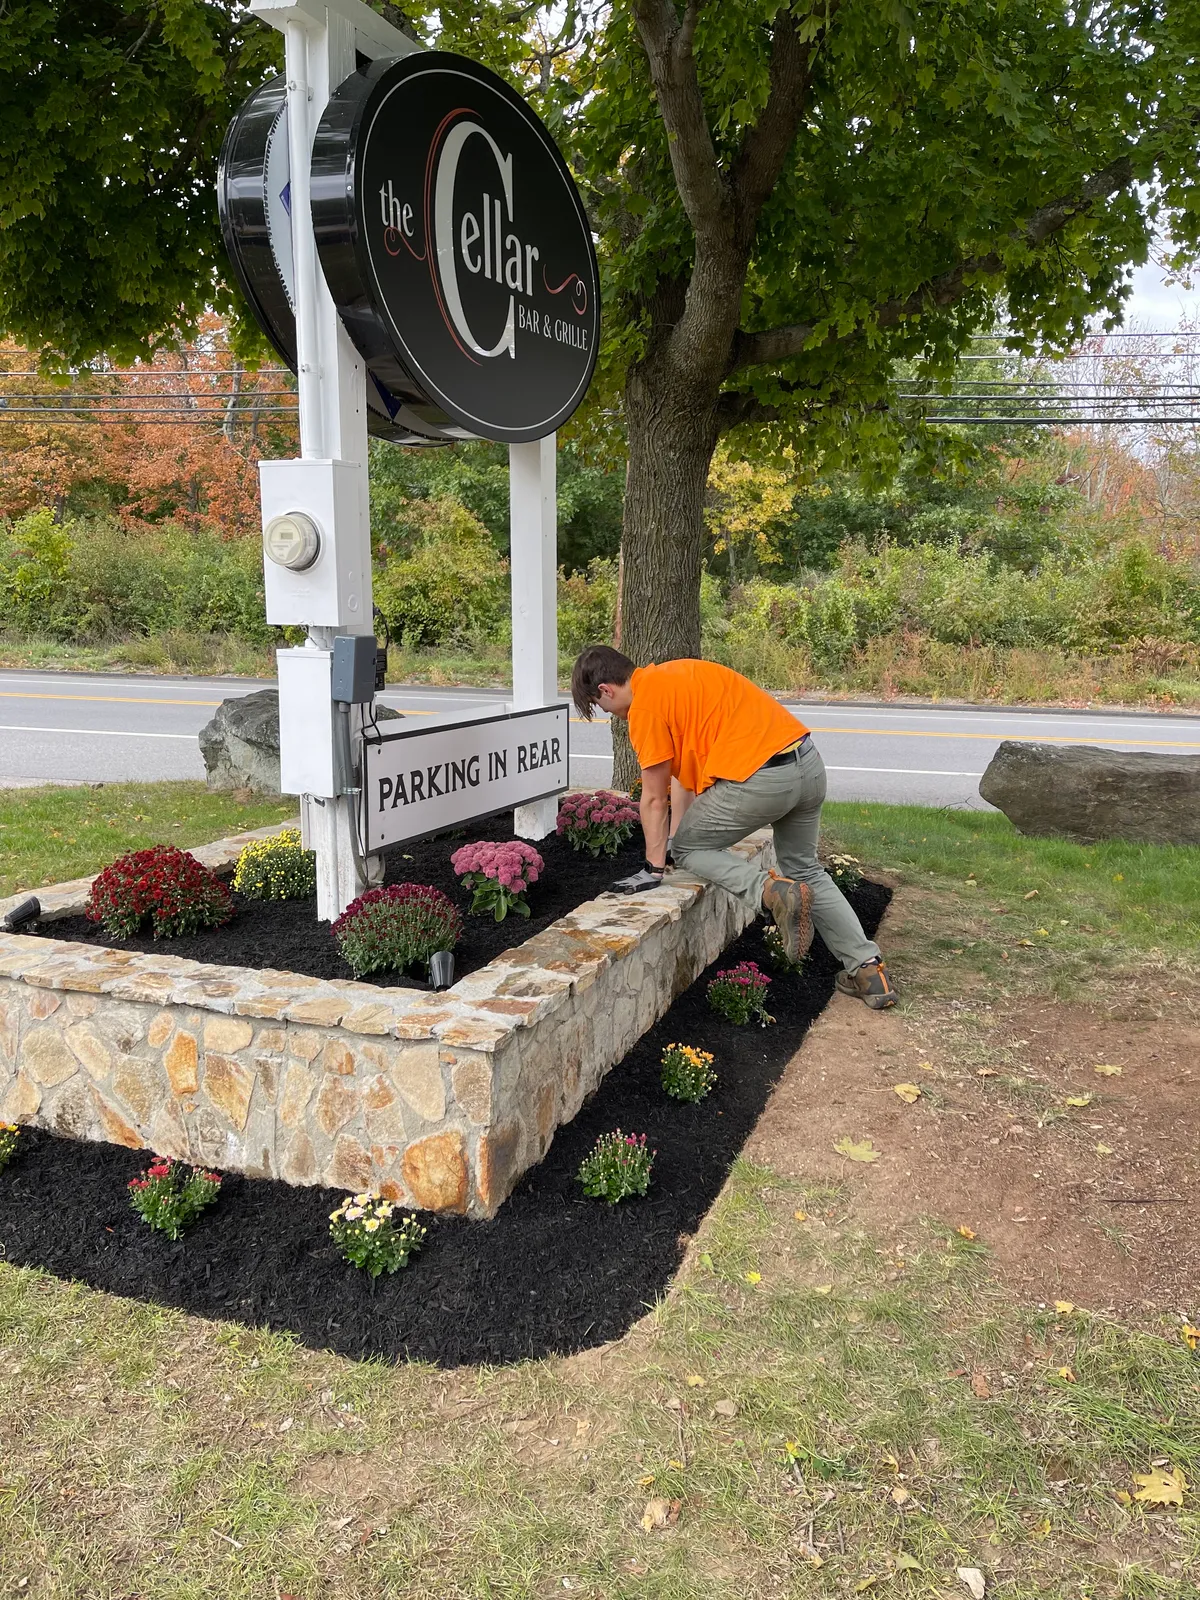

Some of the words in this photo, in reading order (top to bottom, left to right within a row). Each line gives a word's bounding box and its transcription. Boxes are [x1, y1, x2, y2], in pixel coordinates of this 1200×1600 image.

[379, 180, 414, 237] the
[435, 121, 539, 359] Cellar
[518, 304, 540, 334] BAR
[543, 315, 551, 338] &
[555, 319, 588, 351] GRILLE
[378, 755, 480, 812] PARKING
[488, 749, 507, 781] IN
[517, 737, 561, 773] REAR
